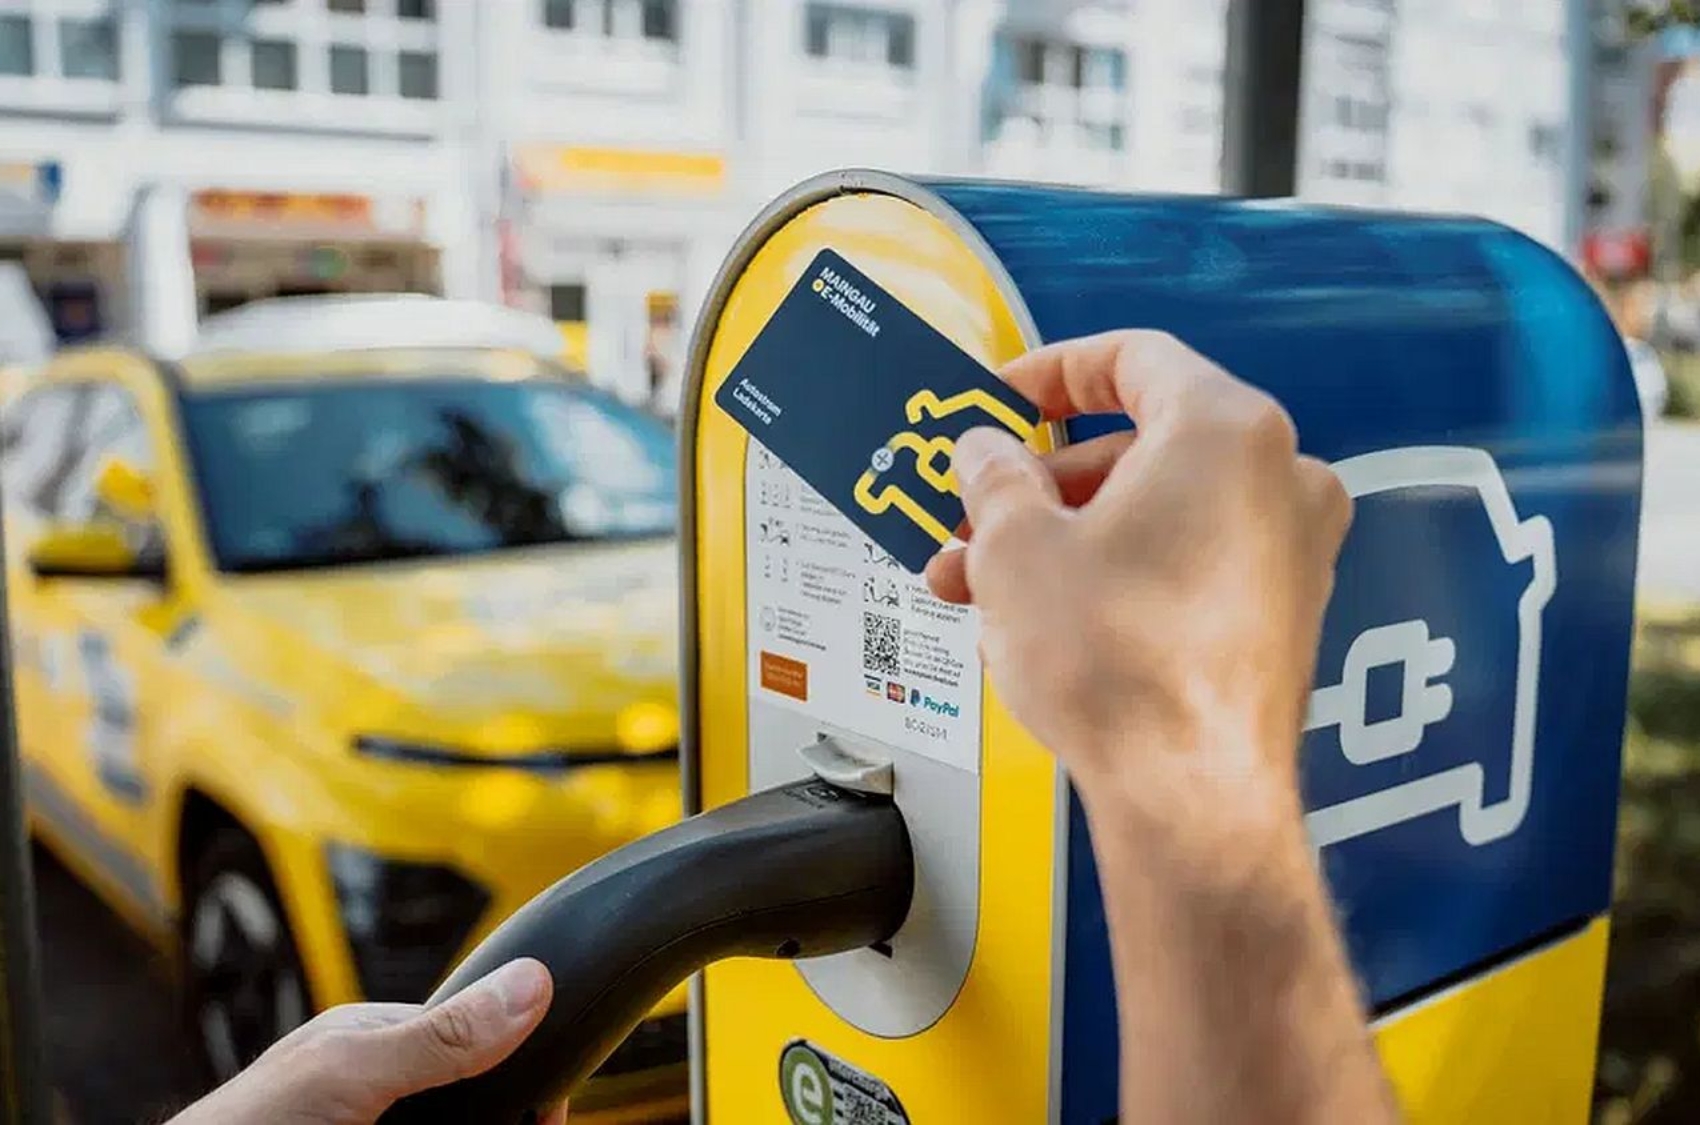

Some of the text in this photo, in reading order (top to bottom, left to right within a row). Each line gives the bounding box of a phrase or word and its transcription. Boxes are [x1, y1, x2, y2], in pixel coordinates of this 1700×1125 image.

[820, 267, 876, 313] MAINGAU
[820, 285, 880, 337] E-Mobilität
[733, 387, 772, 425] Ladekarte
[740, 378, 781, 417] Autostrom
[923, 696, 960, 718] PayPal
